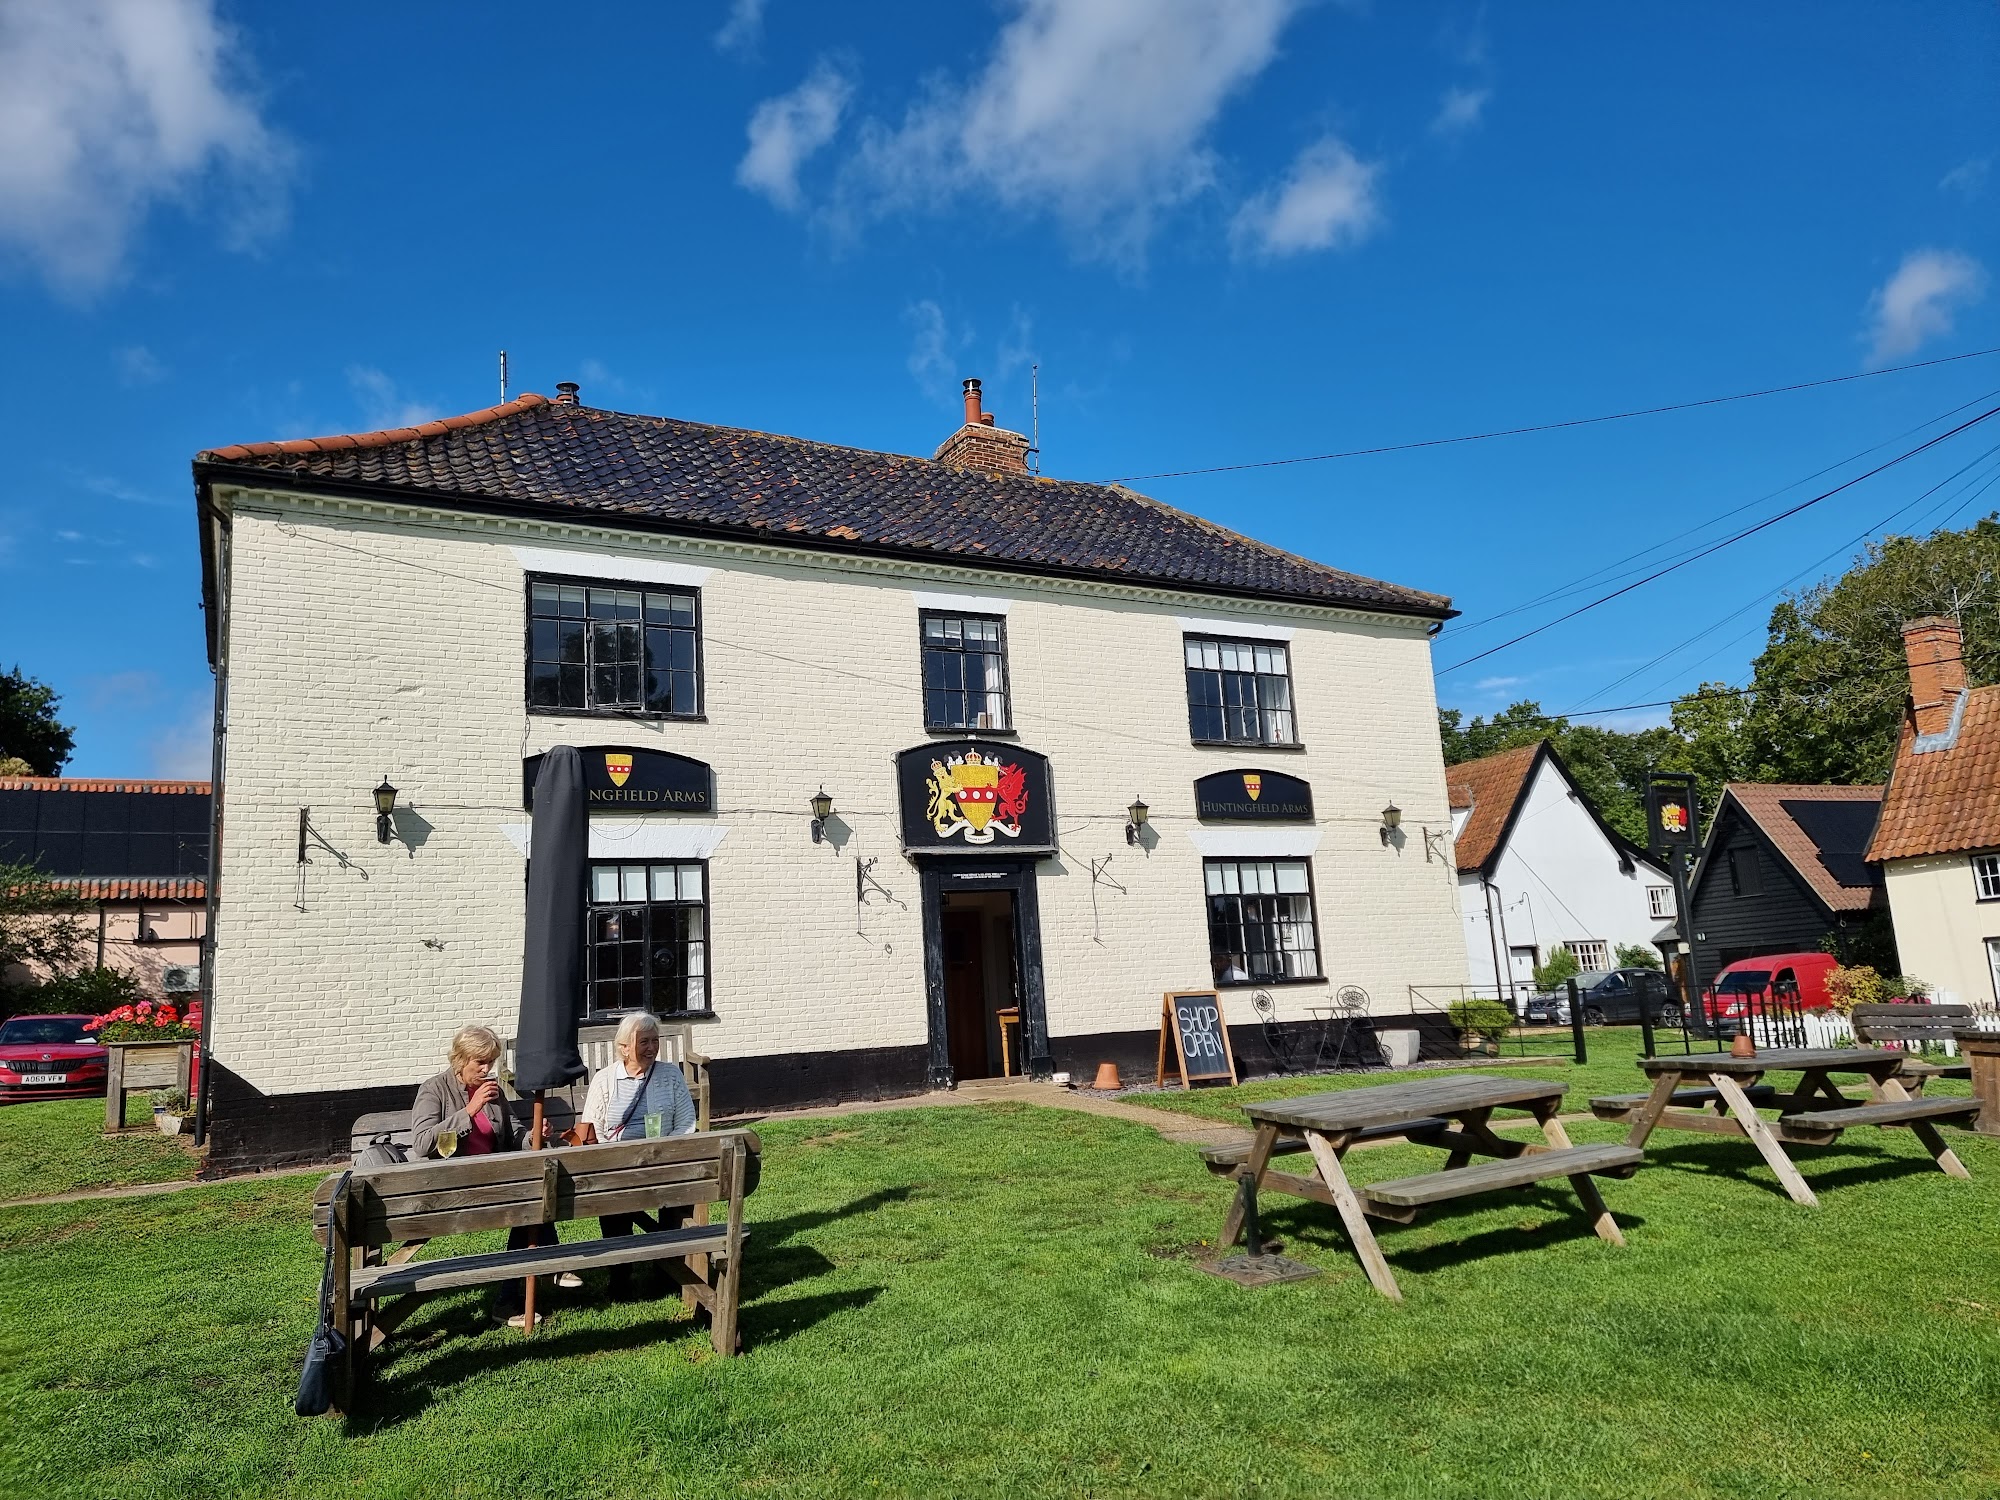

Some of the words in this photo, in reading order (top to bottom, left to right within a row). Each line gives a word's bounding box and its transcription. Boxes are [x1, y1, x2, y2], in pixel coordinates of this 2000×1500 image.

[588, 788, 659, 802] NGFIELD
[663, 789, 705, 803] ARMS
[1202, 801, 1279, 813] HUNTINGFIELD
[1281, 803, 1308, 814] ARMS
[1178, 1006, 1219, 1033] SHOP
[1182, 1031, 1224, 1058] OPEN
